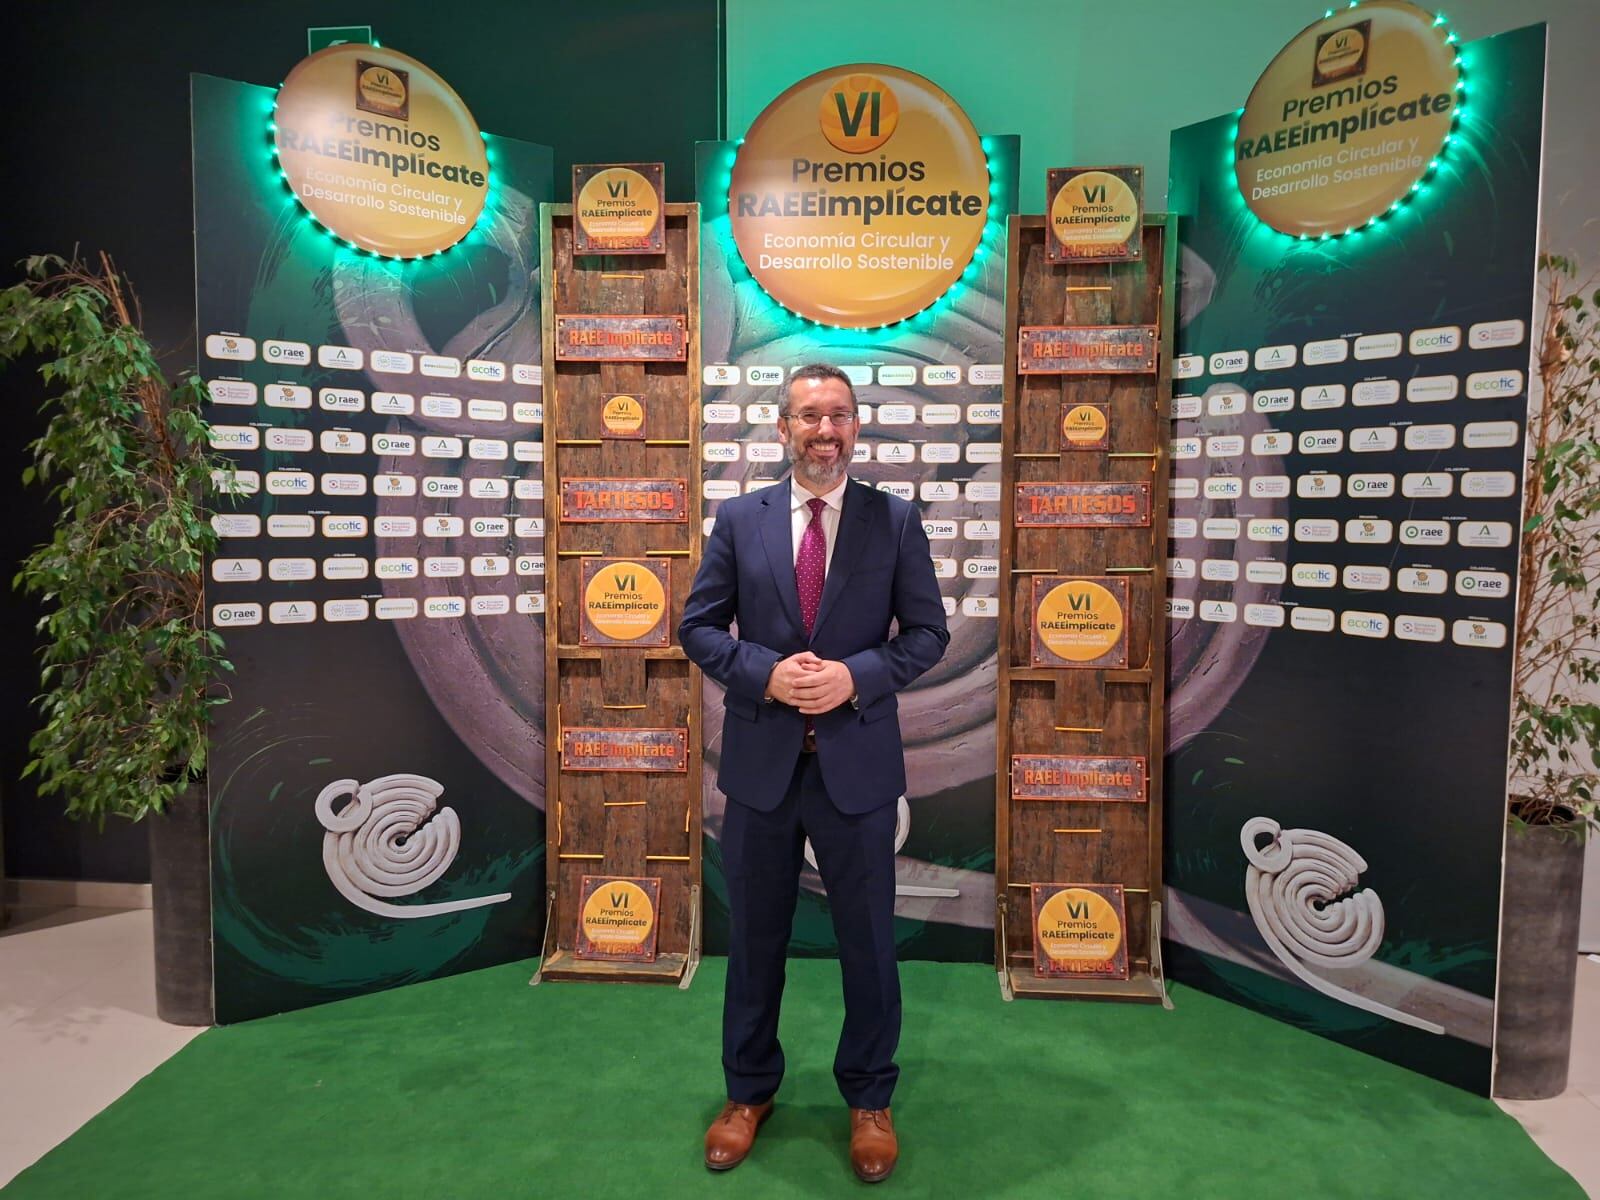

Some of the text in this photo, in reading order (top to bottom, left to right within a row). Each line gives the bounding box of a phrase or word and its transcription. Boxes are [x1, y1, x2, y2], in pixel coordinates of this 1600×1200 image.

[1335, 37, 1348, 49] VI
[376, 72, 389, 86] VI
[1282, 75, 1398, 122] Premios
[834, 91, 881, 137] VI
[329, 111, 441, 151] Premios
[1238, 93, 1452, 160] RAEEimplícate
[279, 129, 485, 188] RAEEimplícate
[1256, 136, 1420, 182] Economía Circular y
[792, 154, 925, 184] Premios
[1252, 154, 1423, 200] Desarrollo Sostenible
[305, 168, 463, 211] Economía Circular y
[607, 180, 629, 198] VI
[1082, 184, 1106, 203] VI
[302, 184, 467, 225] Desarrollo Sostenible
[597, 199, 636, 207] Premios
[737, 186, 982, 225] RAEEimplícate
[1072, 204, 1114, 214] Premios
[763, 232, 951, 254] Economía Circular y
[759, 253, 954, 271] Desarrollo Sostenible
[569, 329, 604, 346] RAEE
[1416, 334, 1453, 348] ecotic
[283, 348, 305, 358] raee
[1033, 342, 1070, 359] RAEE
[1225, 357, 1243, 366] raee
[472, 366, 501, 375] ecotic
[762, 371, 780, 379] raee
[927, 370, 957, 380] ecotic
[1474, 378, 1515, 391] ecotic
[338, 396, 359, 404] raee
[1270, 396, 1289, 404] raee
[618, 402, 629, 411] VI
[972, 408, 1000, 418] ecotic
[1079, 412, 1091, 421] VI
[390, 440, 410, 449] raee
[1317, 437, 1337, 445] raee
[708, 447, 735, 456] ecotic
[272, 478, 308, 488] ecotic
[439, 483, 458, 491] raee
[1208, 482, 1237, 492] ecotic
[1367, 480, 1388, 489] raee
[575, 491, 675, 510] TARTESOS
[1030, 495, 1136, 514] TARTESOS
[328, 521, 361, 531] ecotic
[487, 523, 504, 531] raee
[1252, 524, 1283, 535] ecotic
[1420, 527, 1443, 536] raee
[381, 563, 413, 573] ecotic
[1297, 570, 1331, 580] ecotic
[614, 575, 636, 592] VI
[1477, 579, 1502, 589] raee
[604, 592, 643, 600] Premios
[429, 601, 460, 611] ecotic
[1067, 593, 1091, 611] VI
[1173, 603, 1190, 612] raee
[233, 610, 255, 619] raee
[1057, 611, 1099, 620] Premios
[1347, 618, 1383, 631] ecotic
[574, 742, 608, 757] RAEE
[1024, 769, 1060, 786] RAEE
[610, 892, 629, 908] VI
[600, 908, 634, 917] Premios
[1066, 901, 1089, 919] VI
[1057, 920, 1098, 929] Premios
